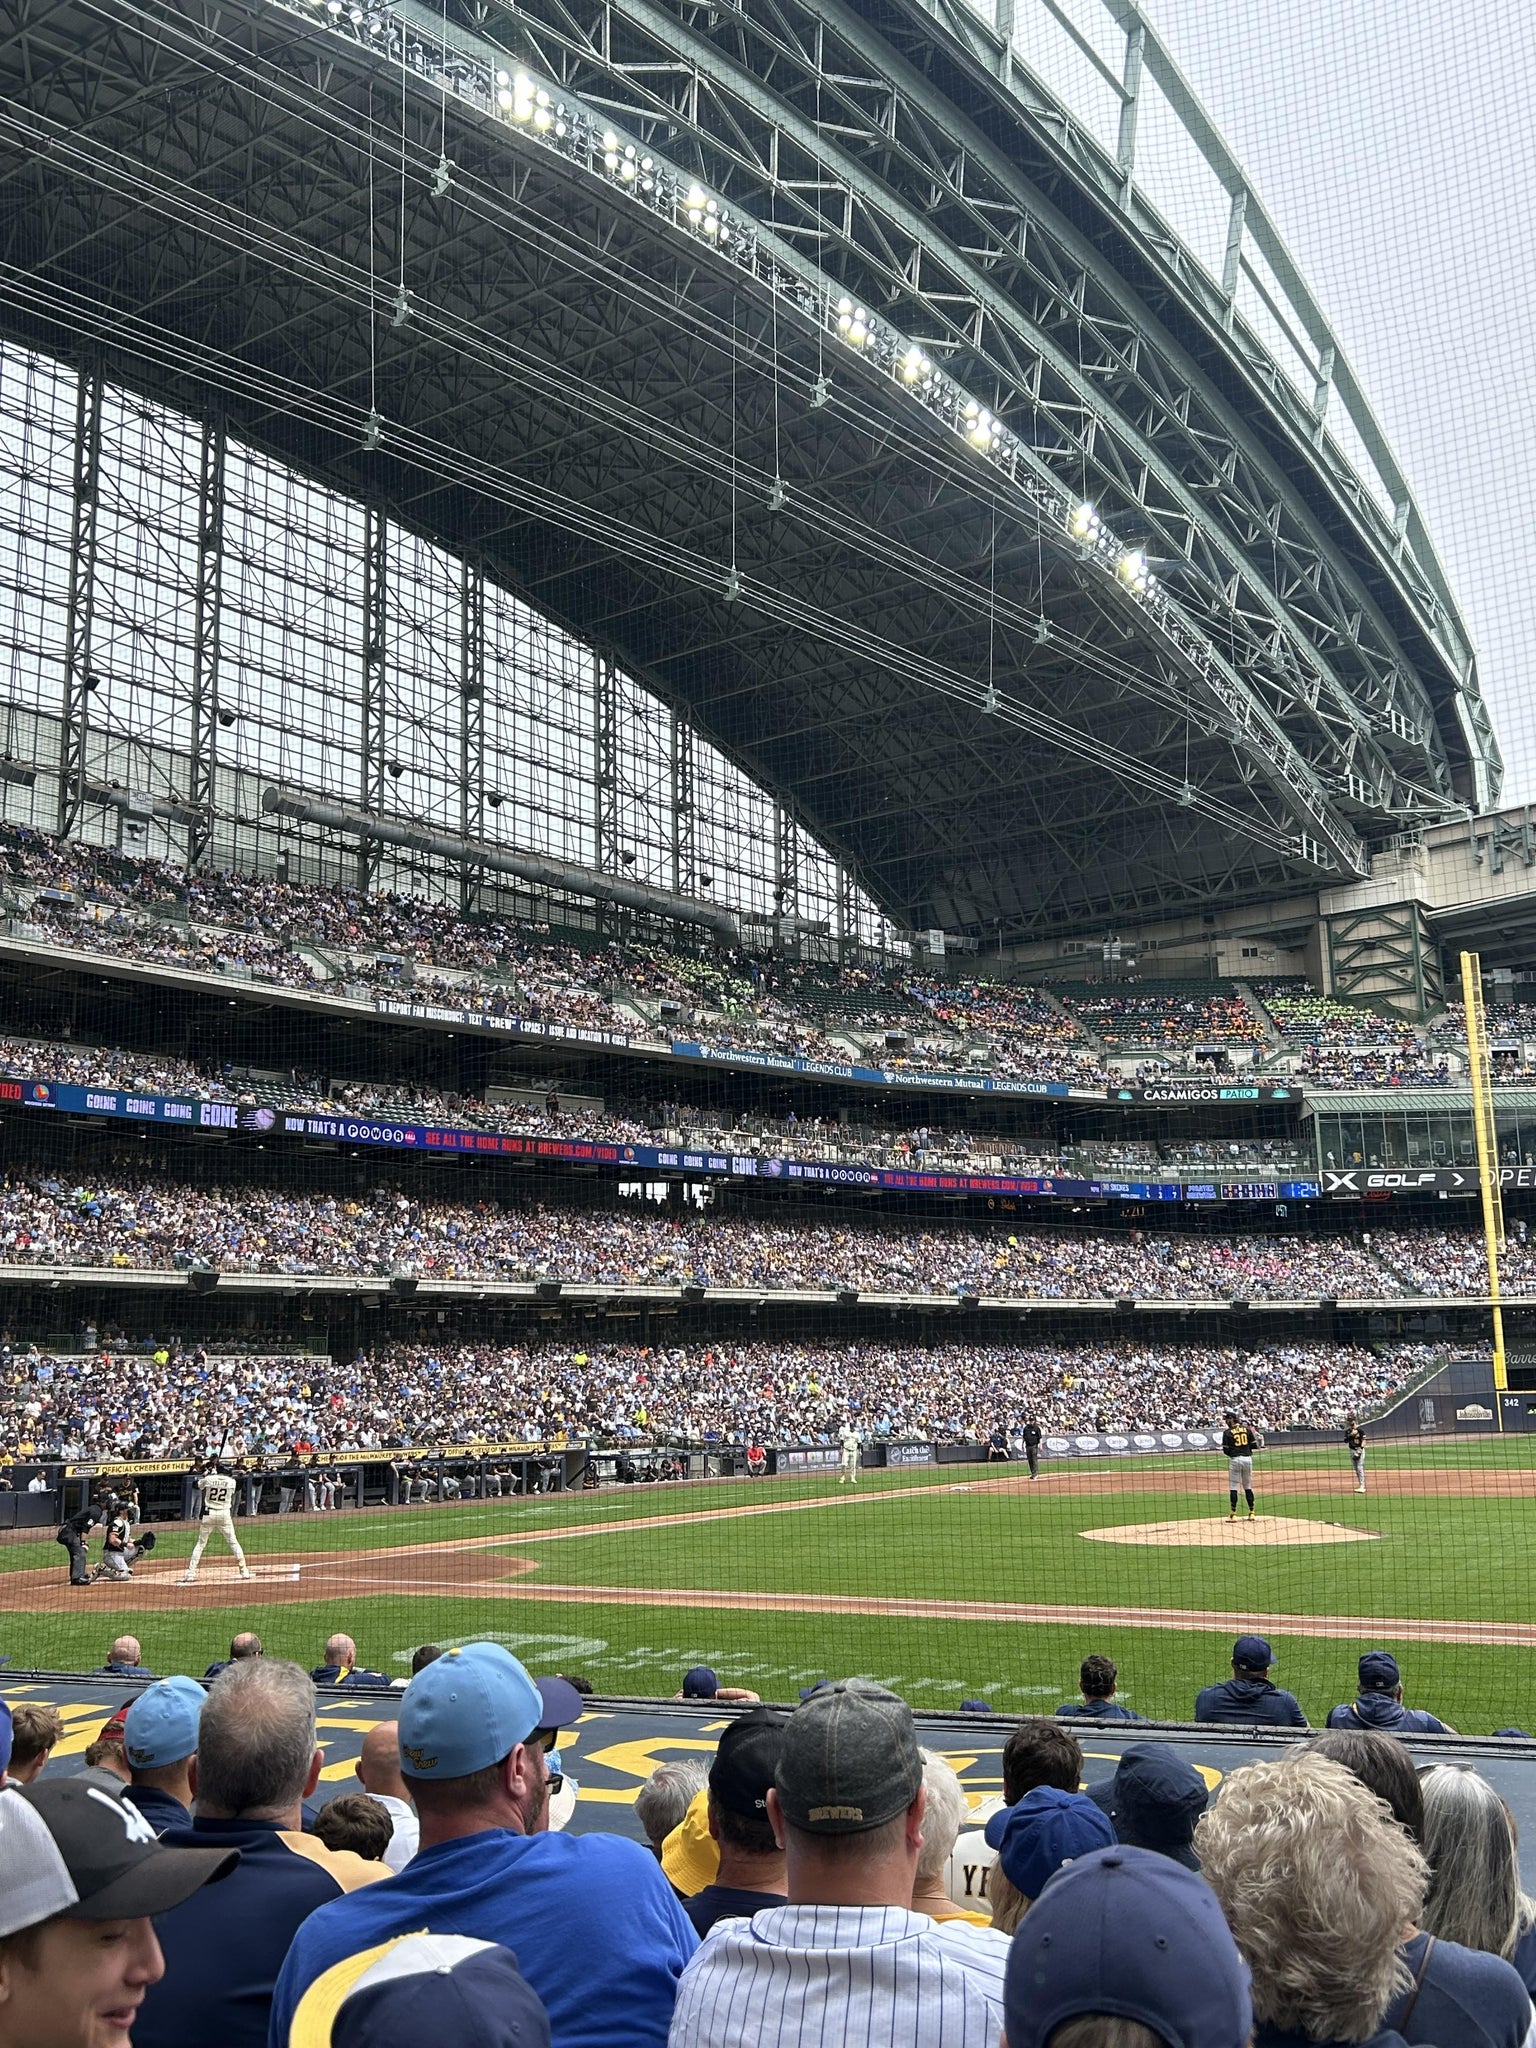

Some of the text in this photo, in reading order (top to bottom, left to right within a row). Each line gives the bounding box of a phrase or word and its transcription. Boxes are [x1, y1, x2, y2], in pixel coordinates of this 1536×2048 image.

[379, 1000, 387, 1012] TO
[388, 1002, 411, 1015] REPORT
[412, 1006, 425, 1018] FAN
[468, 1013, 483, 1026] TEXT
[548, 1025, 565, 1038] ISSUE
[566, 1028, 577, 1040] AND
[578, 1028, 602, 1042] LOCATION
[603, 1032, 610, 1043] TO
[710, 1048, 852, 1078] Northwestern Mutual LEGENDS CLUB
[895, 1074, 1048, 1093] Northwestern Mutual LEGENDS CLUB
[1143, 1089, 1254, 1100] CASAMIGOS PATIO
[86, 1094, 238, 1129] GOING GOING GOING GONE
[285, 1117, 305, 1132] NOW
[306, 1119, 337, 1136] THAT'S
[338, 1123, 345, 1137] A
[425, 1131, 617, 1160] SEE ALL THE HOME RUNS AT BREWERS.COM/VIDEO
[658, 1152, 758, 1175] GOING GOING GOING GONE
[1367, 1173, 1437, 1187] GOLF
[1291, 1182, 1320, 1197] 1:24
[1504, 1398, 1519, 1407] 342
[1233, 1433, 1248, 1447] 30
[360, 1452, 392, 1461] MILWAUKEE
[102, 1463, 132, 1475] OFFICIAL
[133, 1461, 160, 1474] CHEESE
[161, 1461, 171, 1471] OF
[171, 1460, 185, 1471] THE
[209, 1487, 227, 1502] 22
[808, 1805, 863, 1822] BREWERS
